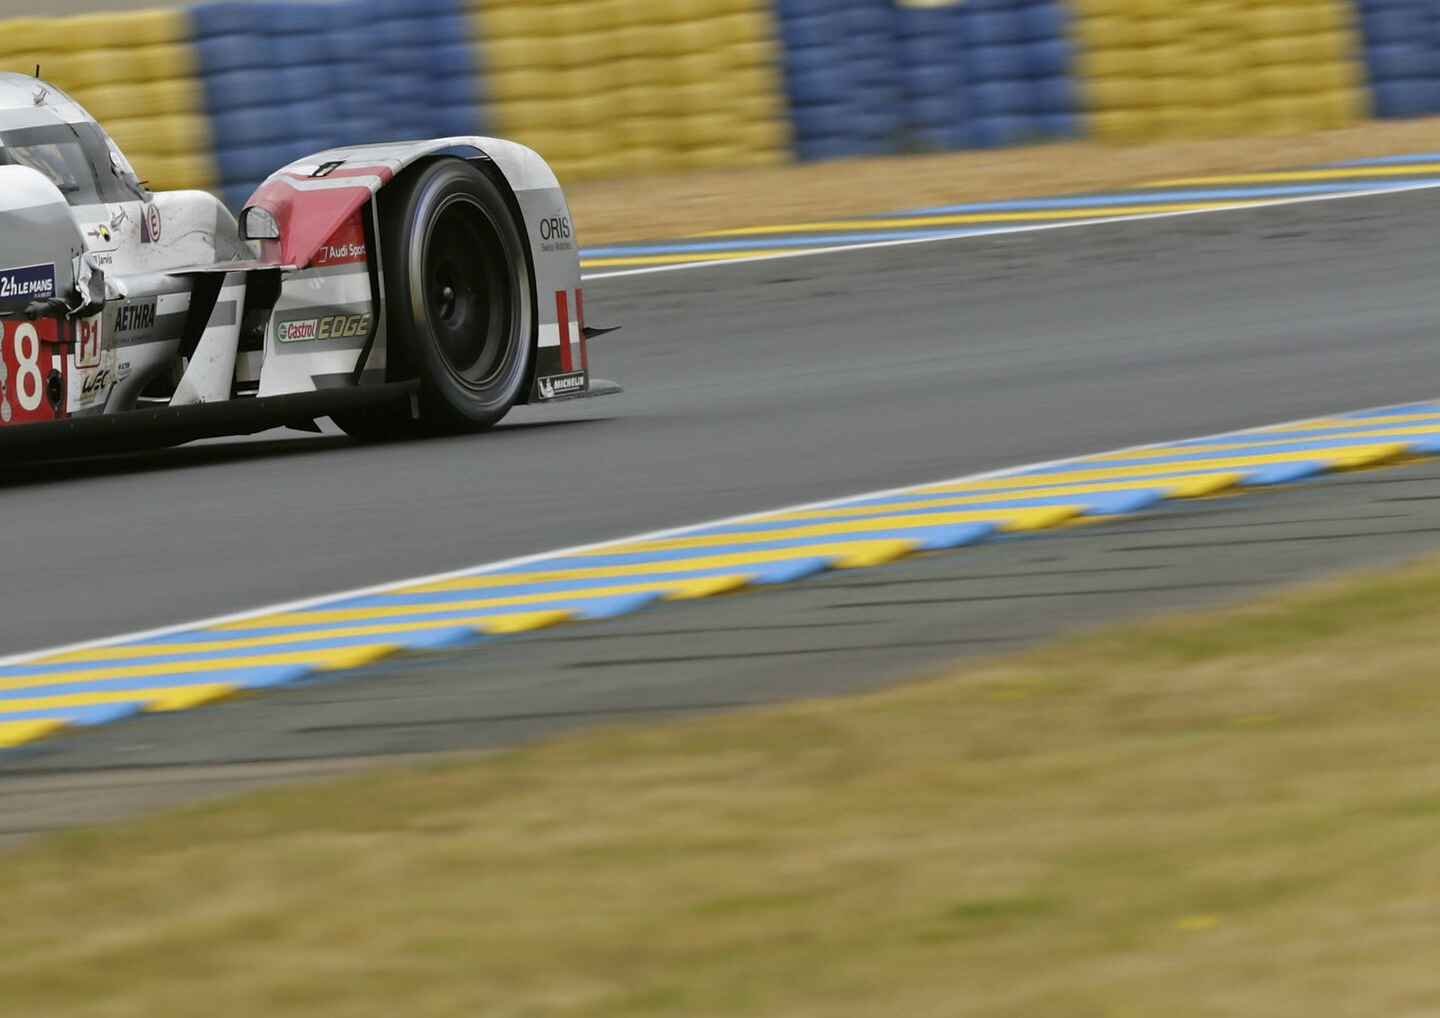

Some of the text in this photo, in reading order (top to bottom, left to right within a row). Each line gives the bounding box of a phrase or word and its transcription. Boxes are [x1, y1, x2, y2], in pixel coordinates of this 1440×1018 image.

[540, 217, 570, 240] ORIS
[329, 243, 366, 258] Audi Sport
[0, 276, 17, 297] 24h
[18, 282, 29, 295] LE
[29, 278, 53, 293] MANS
[114, 303, 155, 332] AETHRA
[287, 313, 371, 340] Castrol EDGE
[81, 320, 98, 361] P1
[13, 322, 43, 412] 8
[82, 370, 109, 393] WEC
[554, 376, 584, 390] MICHELIN
